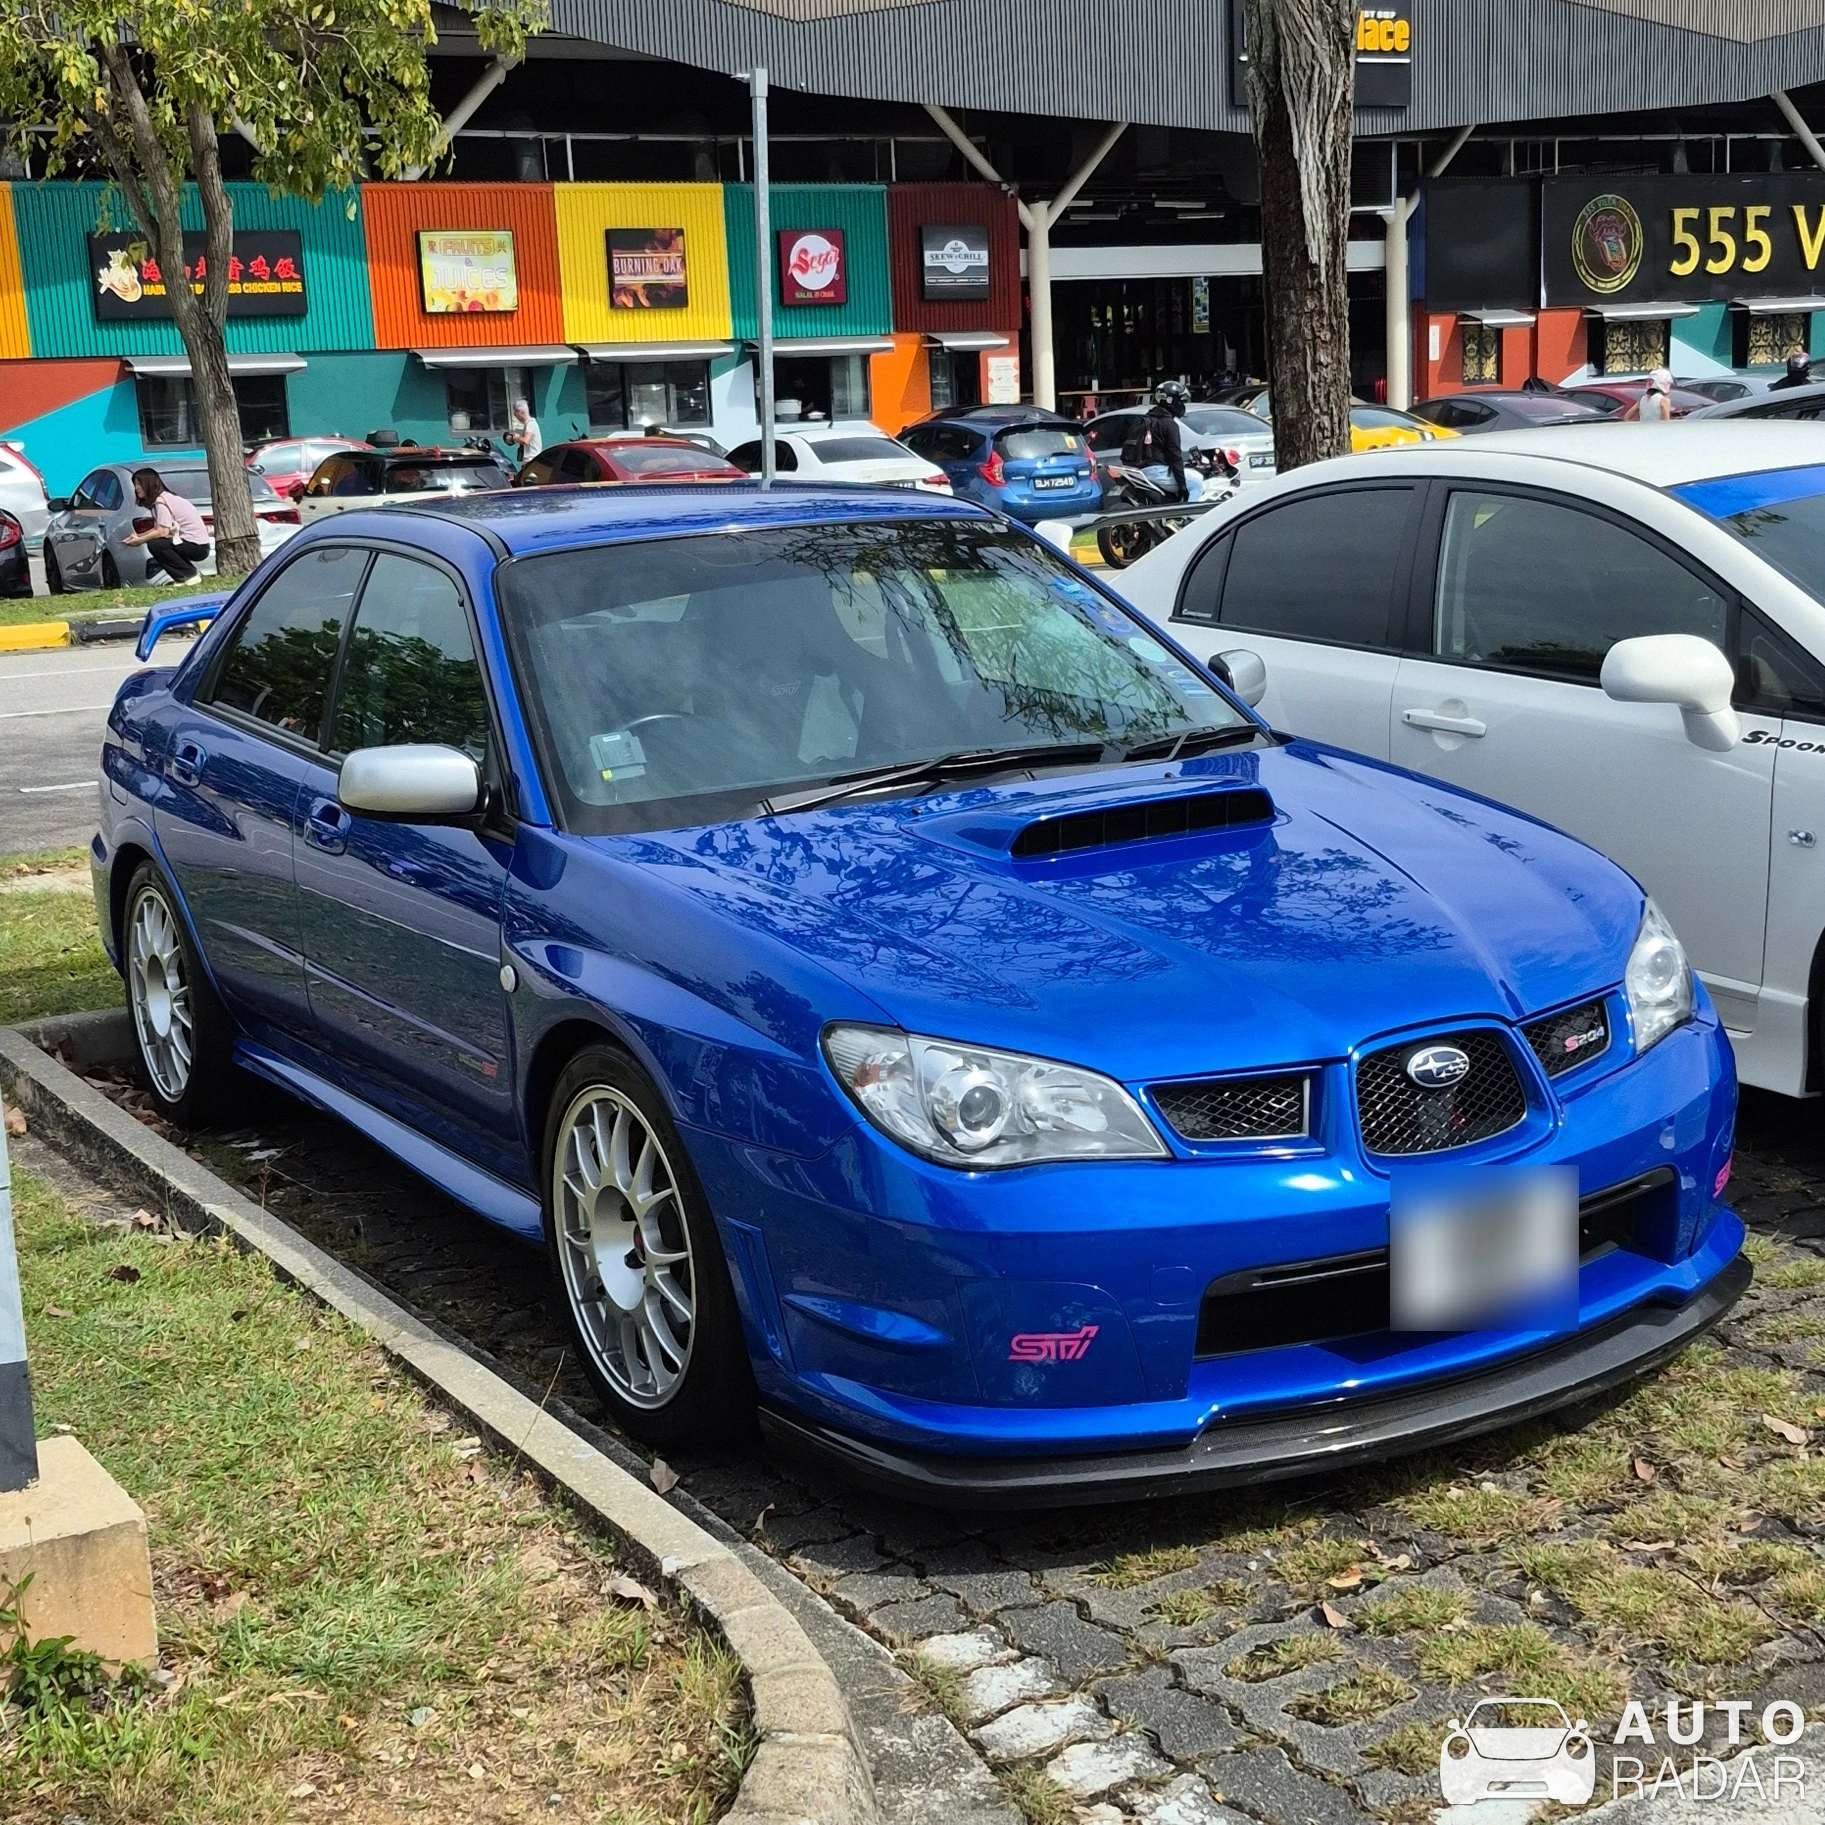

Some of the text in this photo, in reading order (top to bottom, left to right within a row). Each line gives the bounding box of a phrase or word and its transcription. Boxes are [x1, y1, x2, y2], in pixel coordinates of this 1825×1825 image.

[1357, 10, 1410, 52] lace
[442, 239, 493, 255] FRUITS
[1669, 206, 1772, 276] 555
[613, 257, 683, 274] BURNING OAK
[242, 282, 281, 293] CHICKEN
[281, 281, 303, 293] RICE
[431, 267, 509, 291] JUICES
[1564, 1026, 1605, 1052] S204
